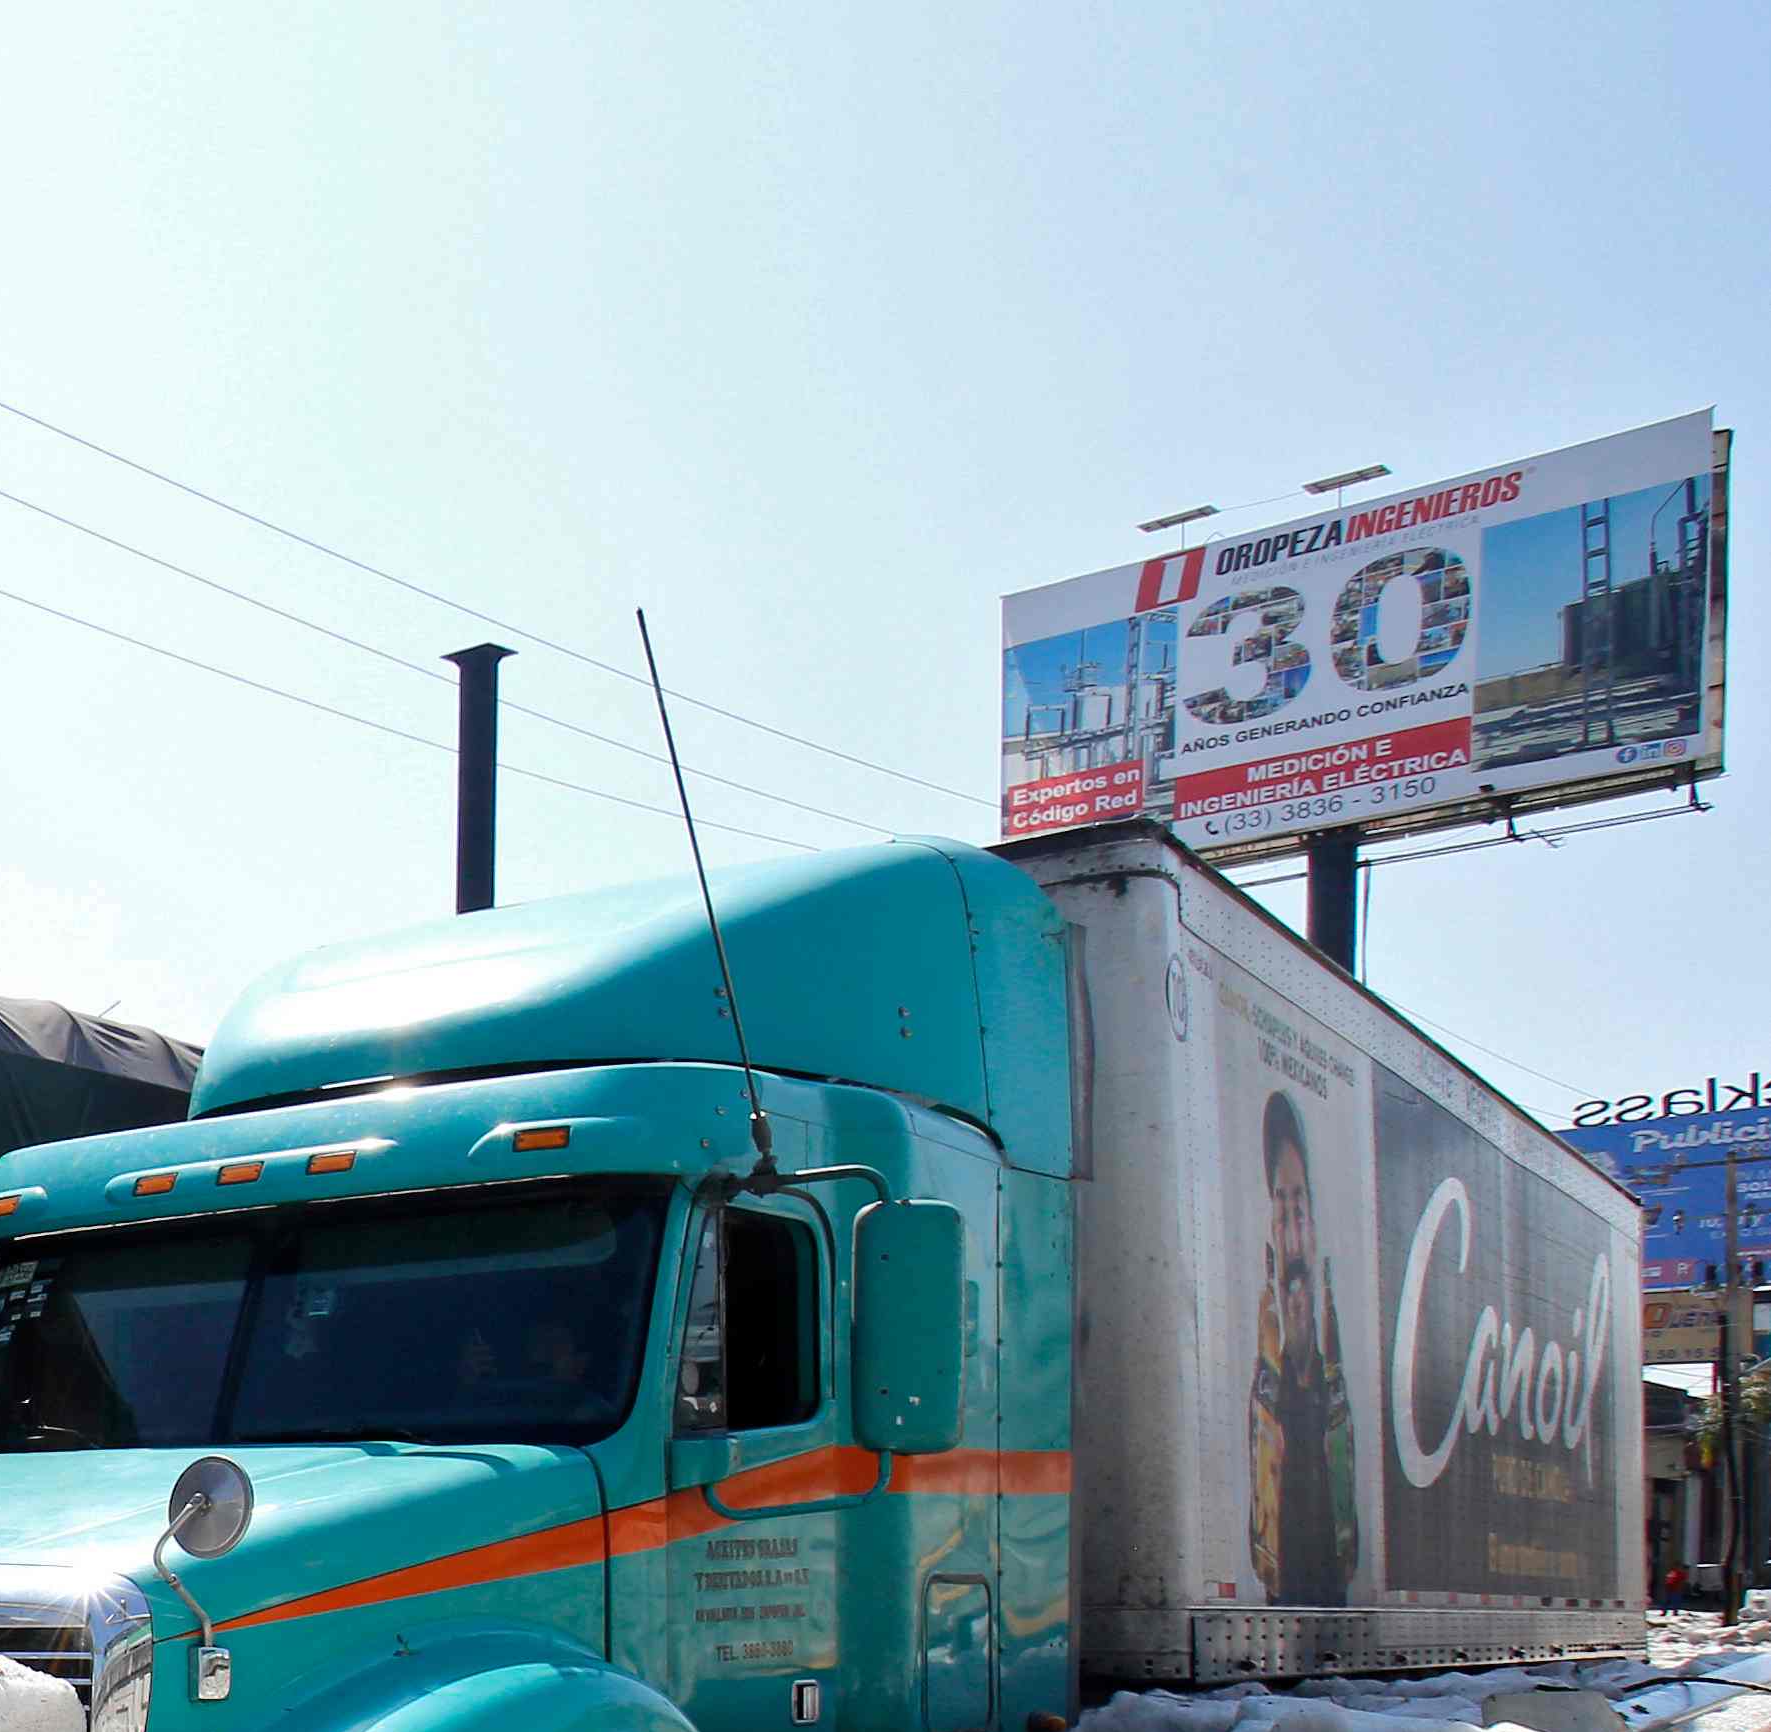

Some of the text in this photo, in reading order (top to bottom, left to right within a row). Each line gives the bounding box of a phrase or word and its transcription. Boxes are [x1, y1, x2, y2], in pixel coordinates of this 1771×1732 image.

[1215, 471, 1523, 576] OROPEZA INGENIEROS
[1182, 546, 1471, 725] 30
[1181, 682, 1469, 755] AÑOS GENERANDO CONFIANZA
[1012, 768, 1141, 806] Expertos en
[1180, 748, 1467, 819] INGENIERÍA ELÉCTRICA
[1246, 738, 1393, 783] MEDICIÓN E
[1012, 789, 1137, 829] Código Red
[1224, 807, 1273, 836] (33)
[1281, 794, 1343, 823] 3836
[1371, 776, 1436, 805] 3150
[1392, 1176, 1610, 1490] Canoil
